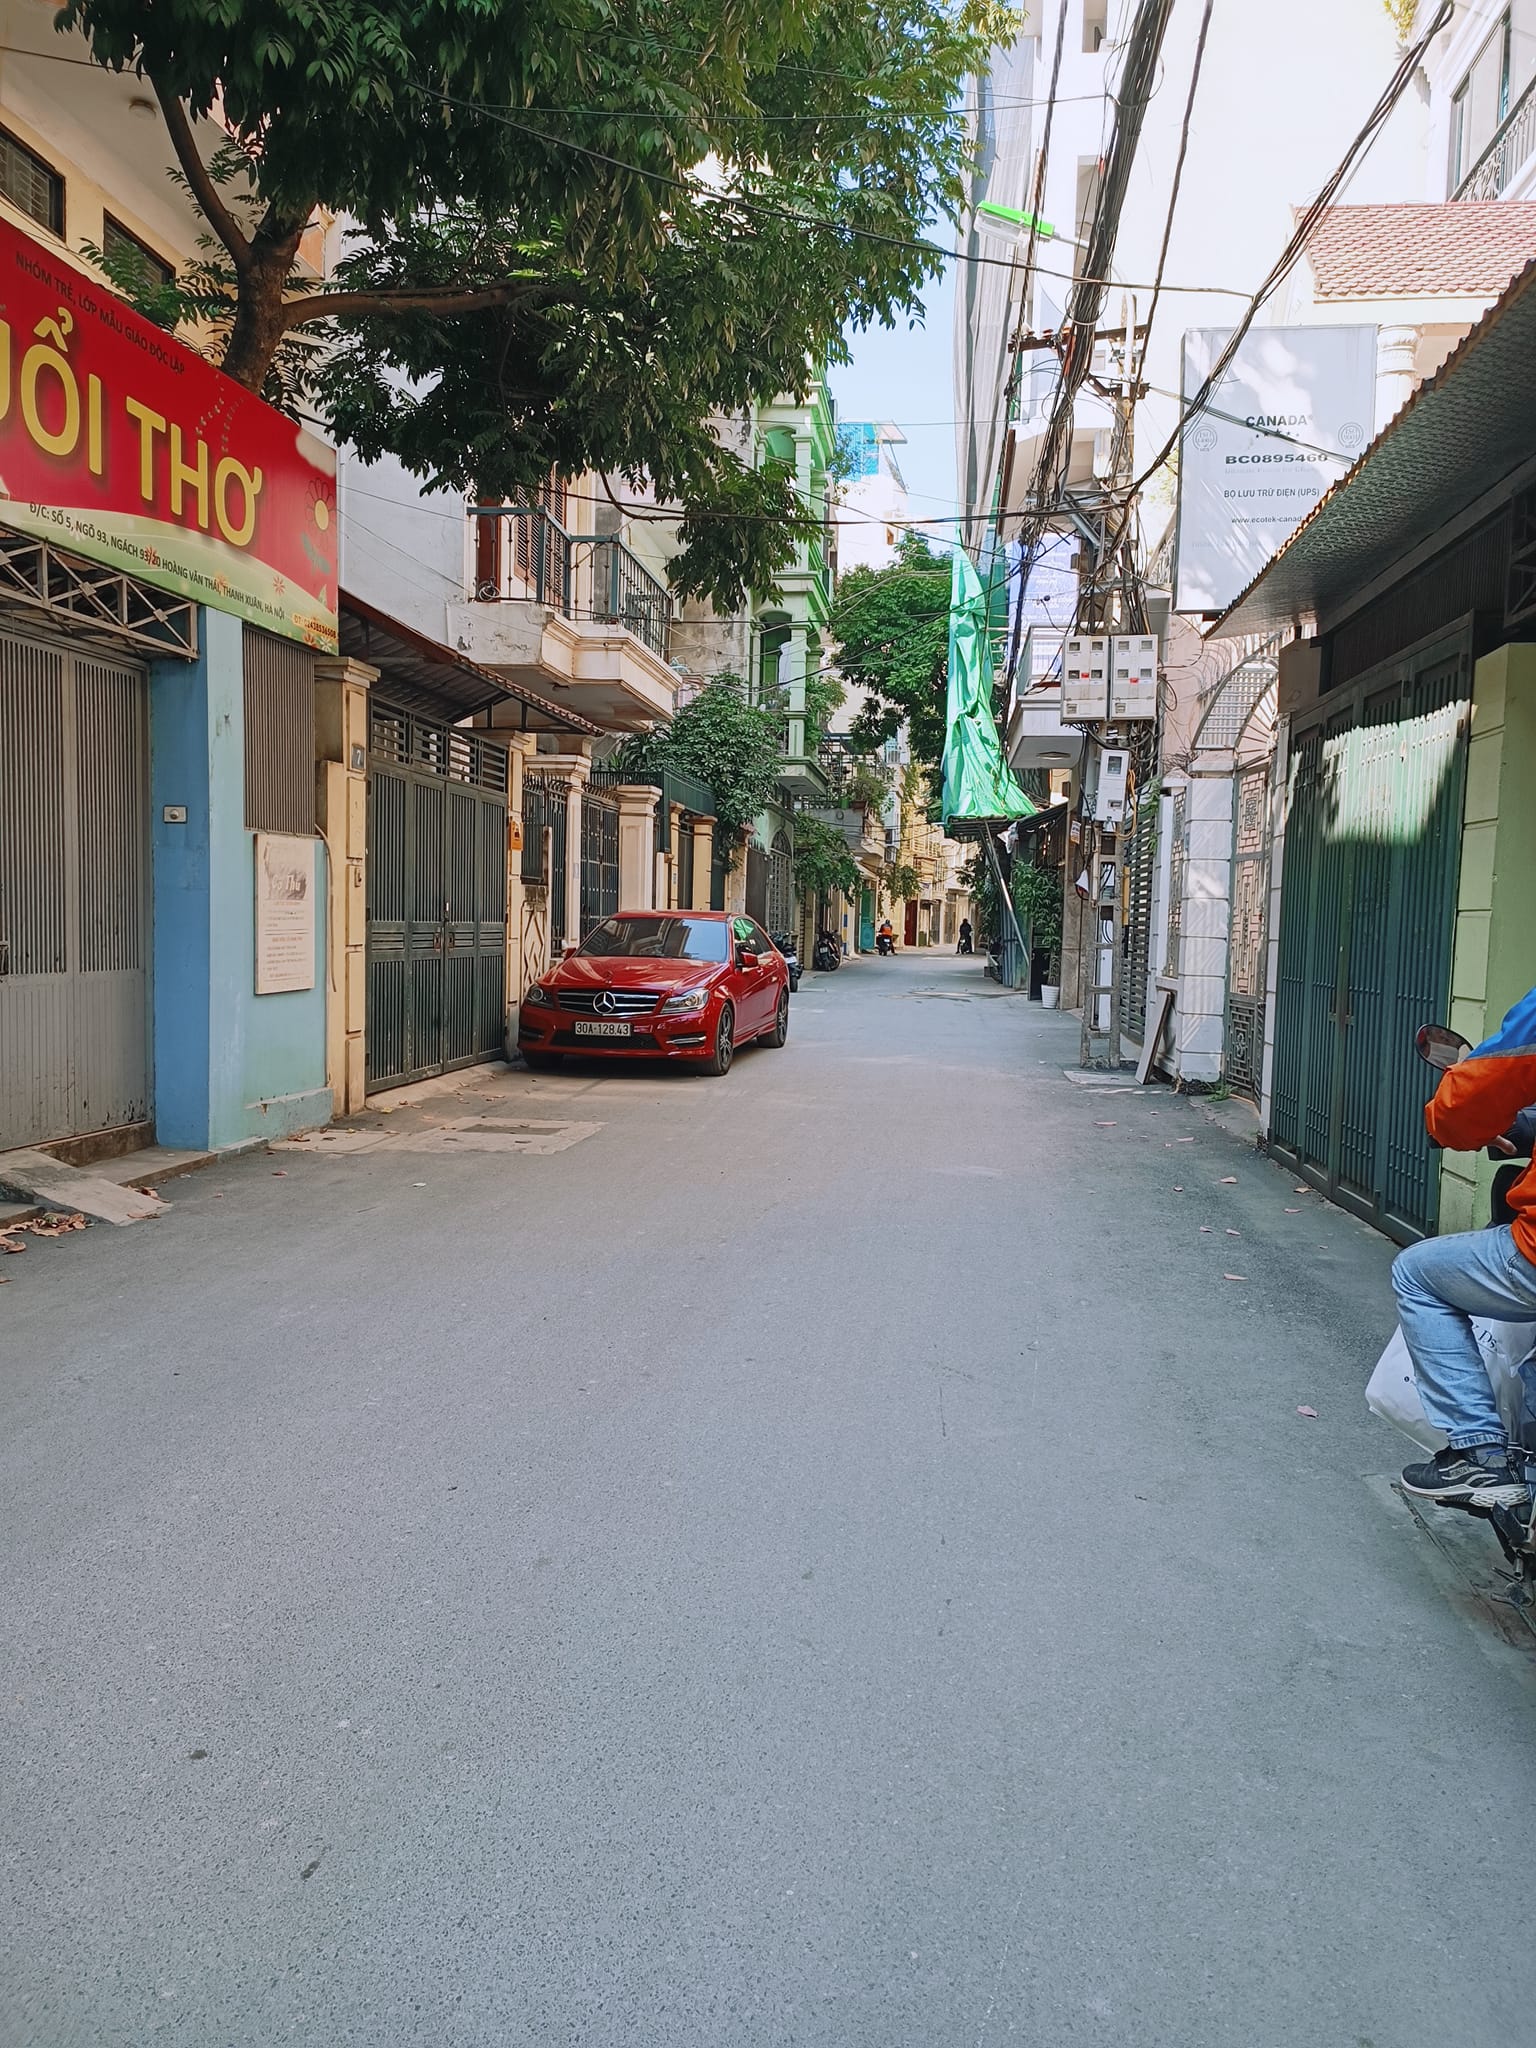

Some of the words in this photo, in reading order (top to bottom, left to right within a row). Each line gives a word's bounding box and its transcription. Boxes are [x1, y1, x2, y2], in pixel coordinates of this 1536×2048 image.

[16, 252, 52, 287] NHÓM
[124, 325, 149, 351] GIÁO
[149, 343, 169, 365] ĐỘC
[0, 307, 103, 477] ỔI
[126, 396, 263, 548] THƠ
[1246, 415, 1308, 428] CANADA
[1276, 487, 1296, 499] ĐIỆN
[1297, 487, 1320, 499] (UPS)
[29, 501, 50, 520] Đ/C:
[51, 508, 64, 525] SỐ
[65, 516, 74, 532] 5,
[75, 520, 95, 538] NGÕ
[96, 529, 109, 547] 93,
[110, 535, 138, 558] NGÁCH
[162, 558, 188, 582] HOÀNG
[188, 569, 204, 586] VĂN
[223, 584, 245, 604] THANH
[244, 594, 264, 613] XUÂN,
[264, 600, 274, 615] HÀ
[273, 605, 285, 620] NỘI
[576, 1022, 629, 1035] 30A-128.43
